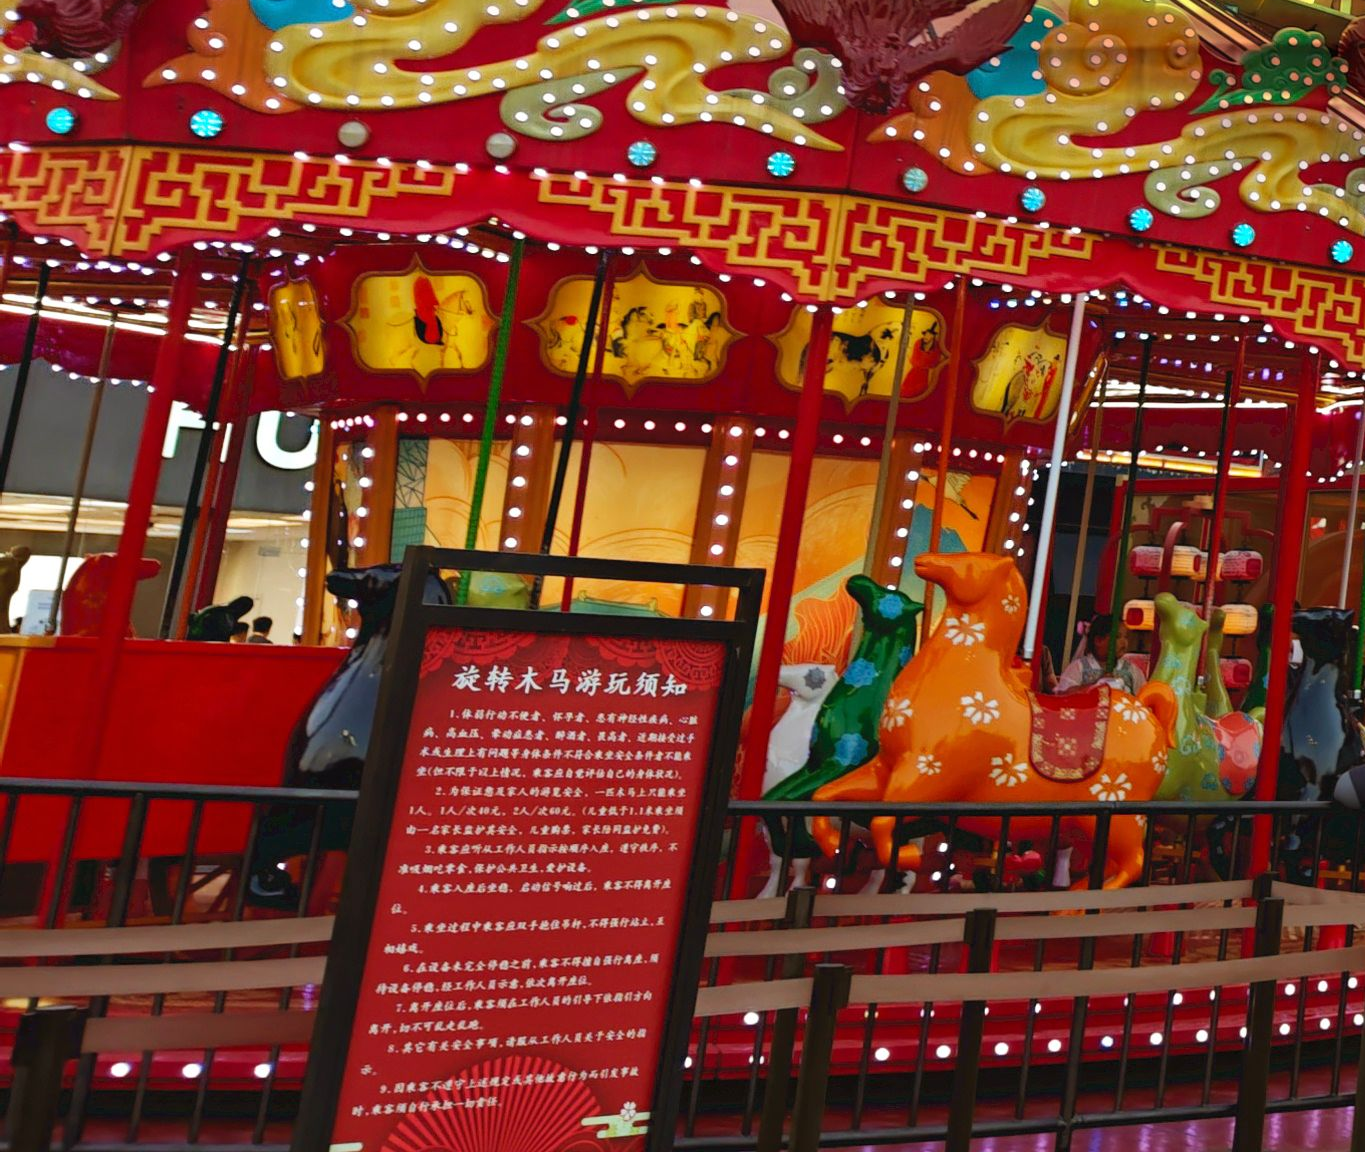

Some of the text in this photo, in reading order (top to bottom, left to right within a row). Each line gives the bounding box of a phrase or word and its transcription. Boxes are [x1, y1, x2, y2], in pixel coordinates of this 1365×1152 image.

[451, 664, 689, 698] 旋转木马游玩须知
